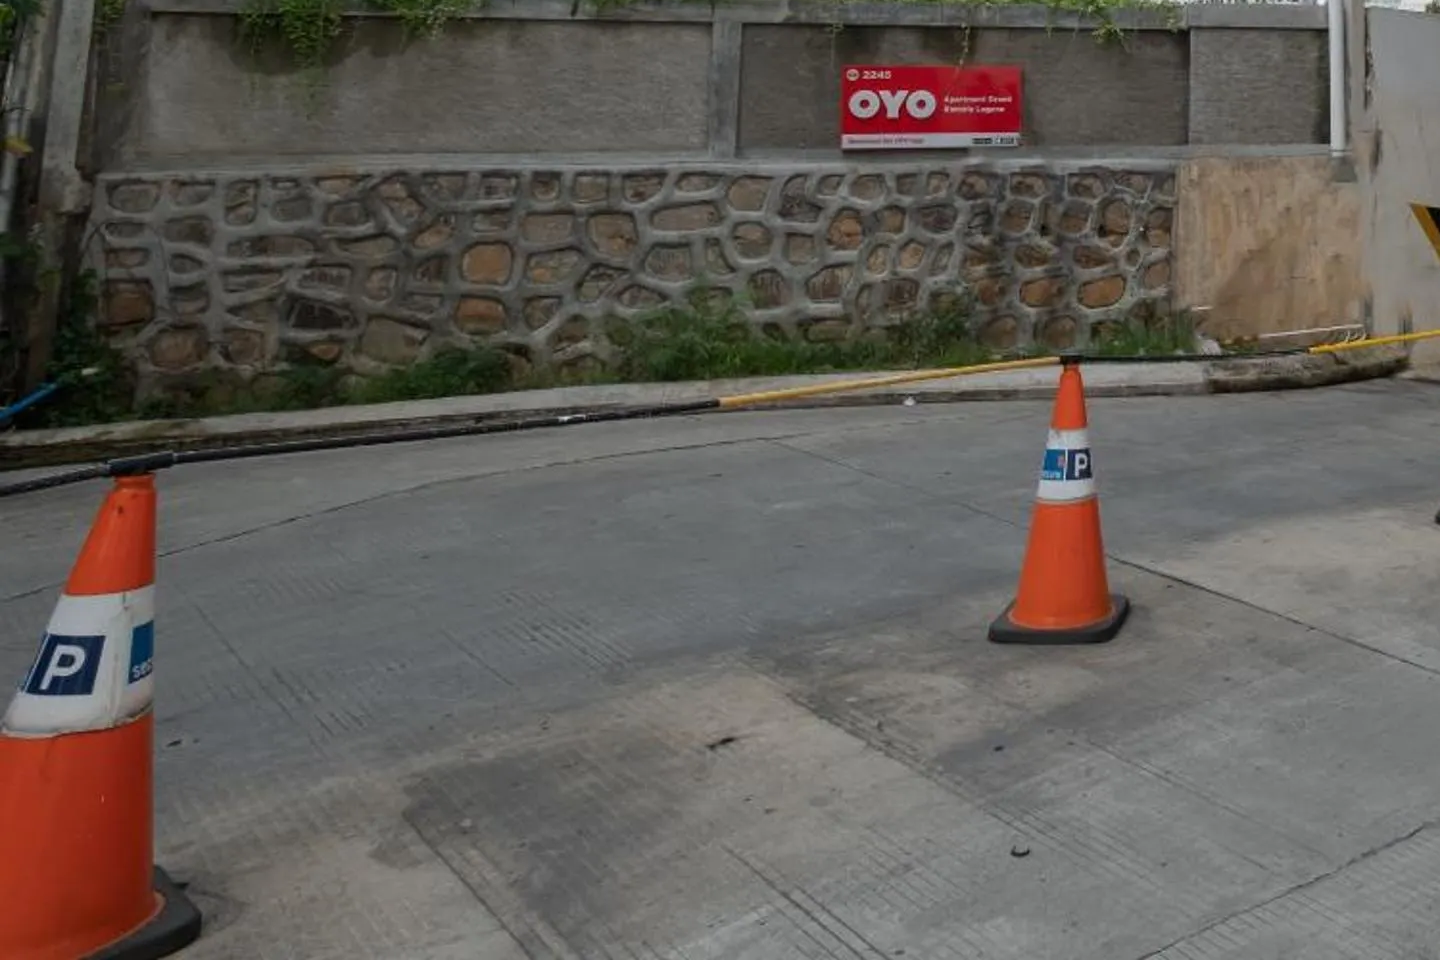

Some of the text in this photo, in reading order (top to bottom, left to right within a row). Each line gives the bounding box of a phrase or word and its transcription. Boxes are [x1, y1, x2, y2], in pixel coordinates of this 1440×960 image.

[848, 89, 937, 120] OYO
[1074, 453, 1088, 478] P
[40, 644, 86, 690] P
